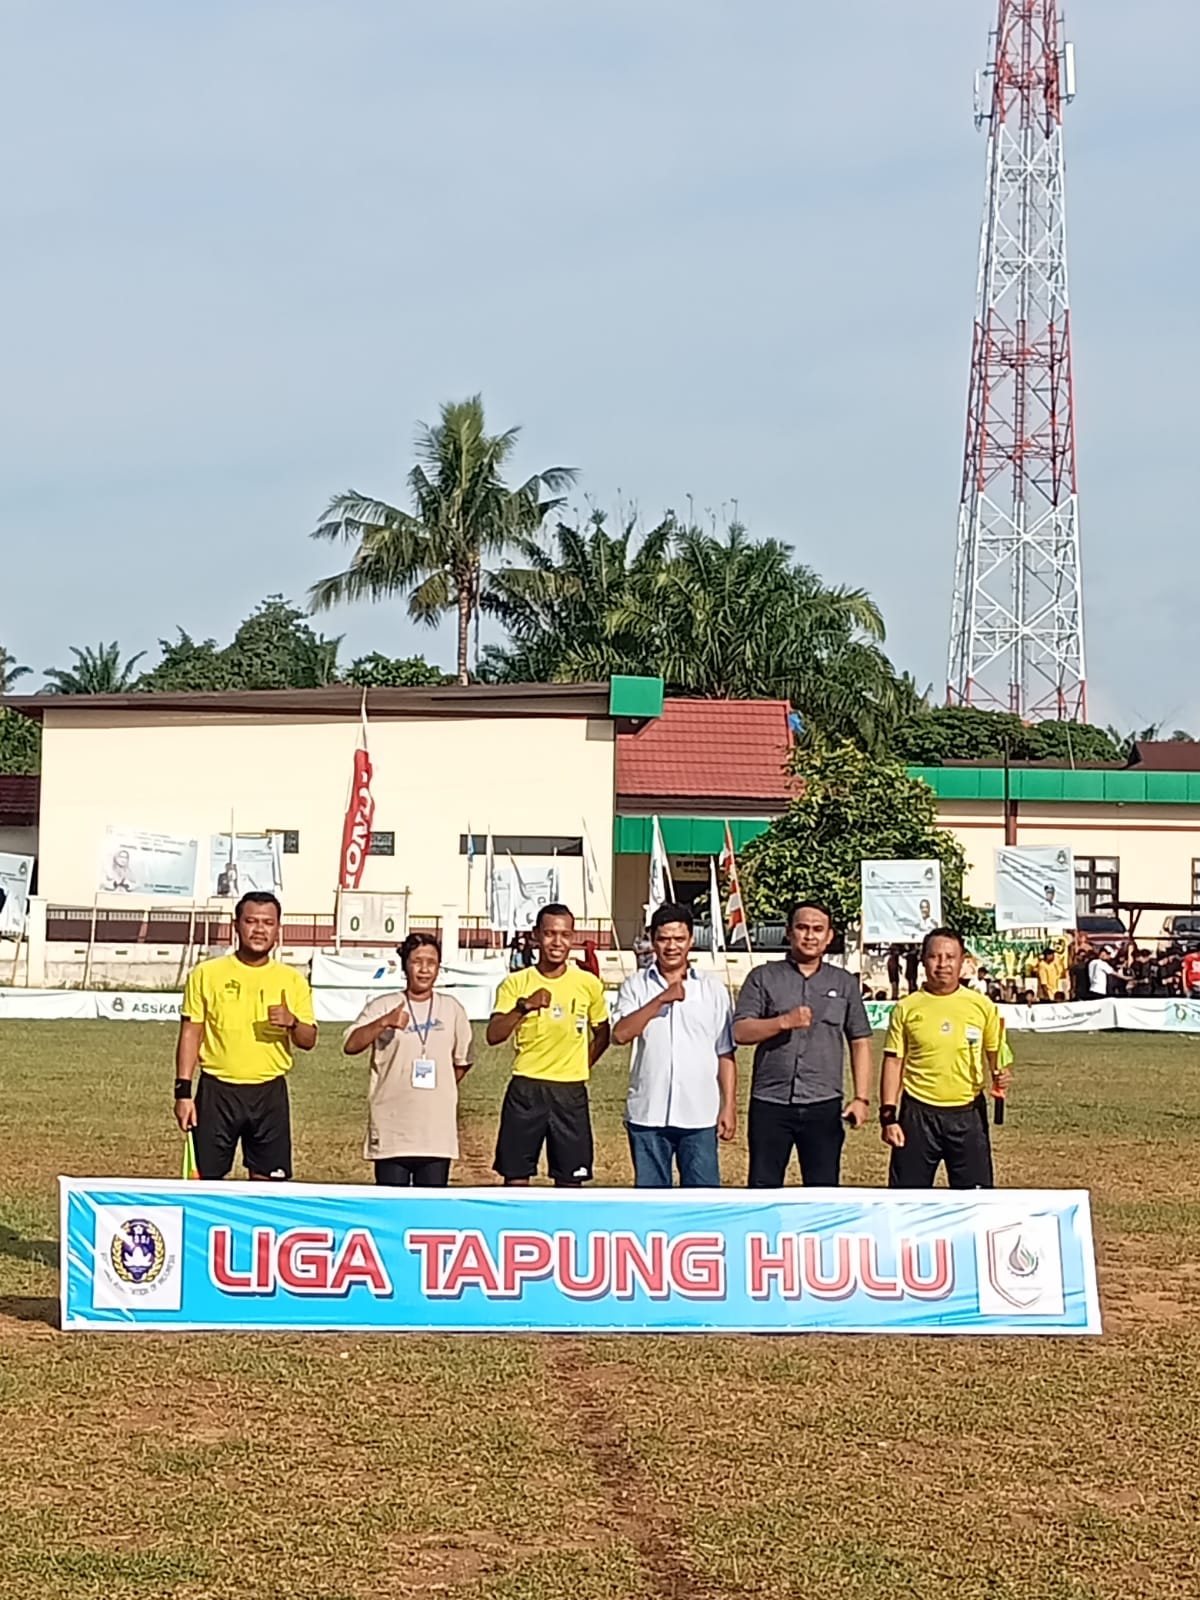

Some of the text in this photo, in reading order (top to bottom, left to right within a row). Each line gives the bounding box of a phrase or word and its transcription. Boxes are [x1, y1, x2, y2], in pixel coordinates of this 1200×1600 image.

[350, 916, 395, 934] 0 0
[211, 1228, 952, 1297] LIGA TAPUNG HULU
